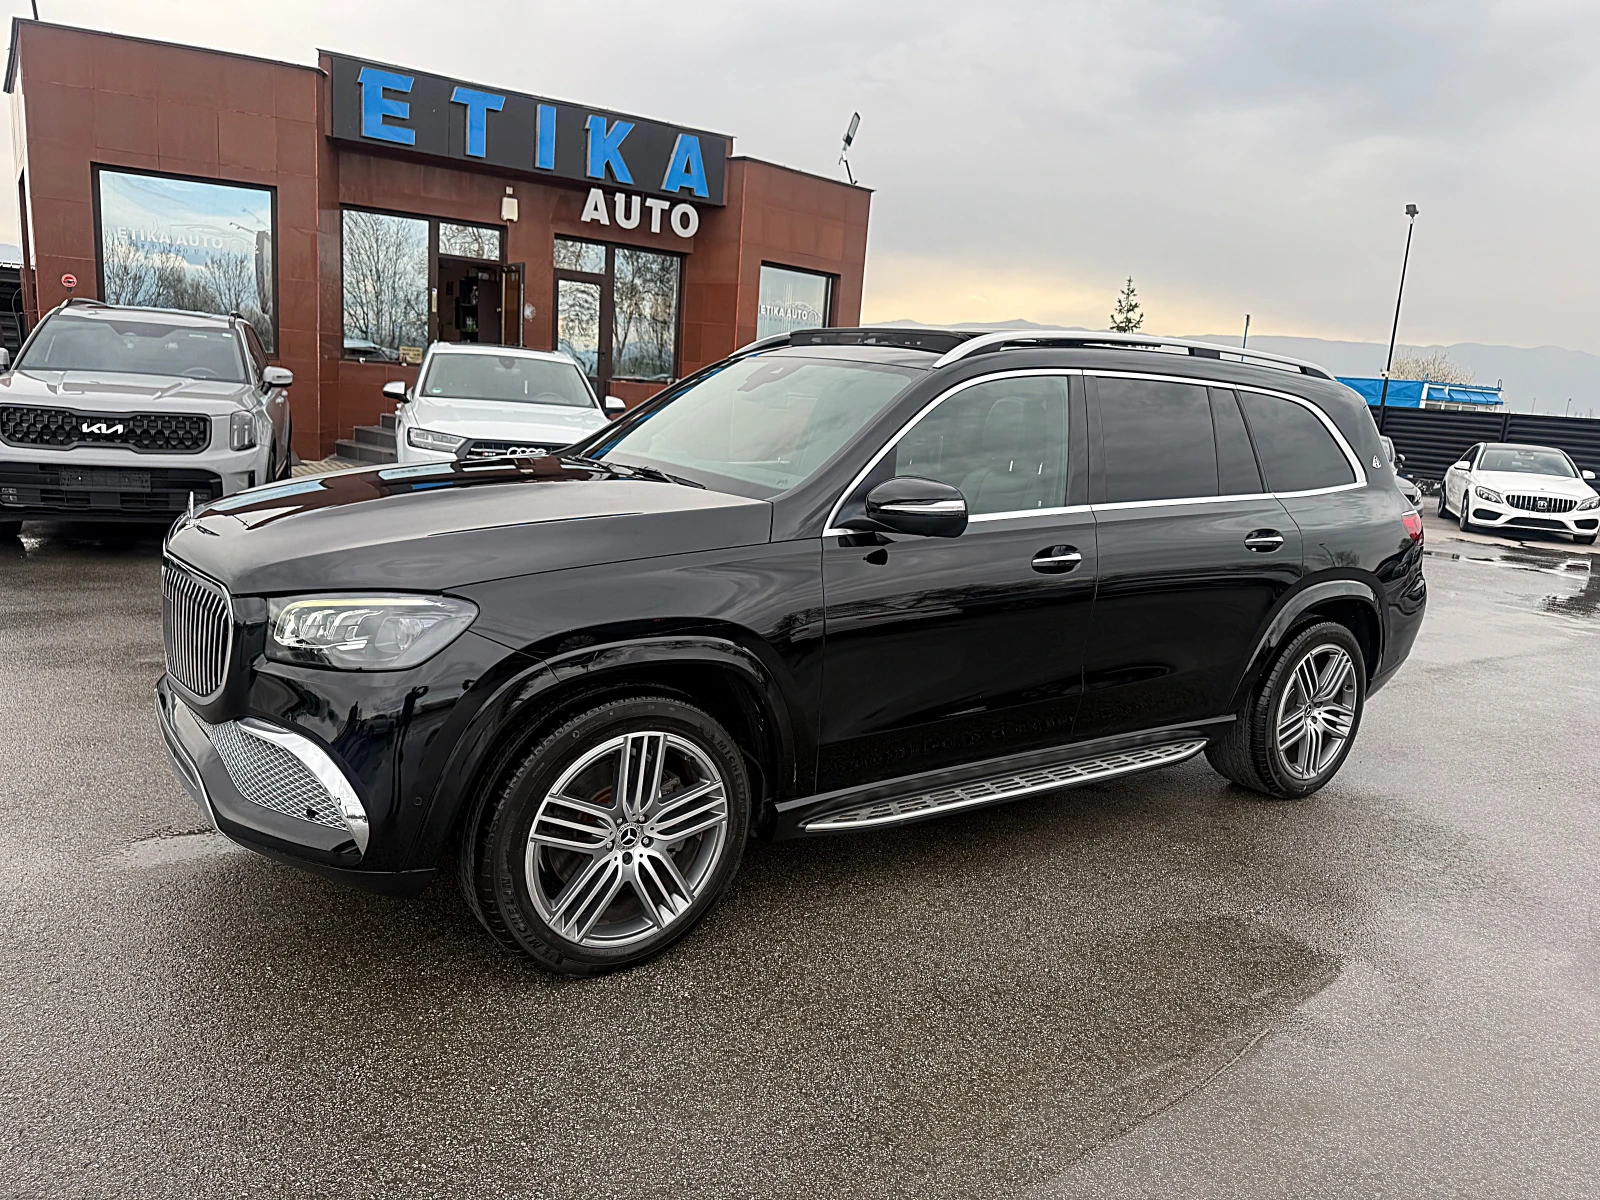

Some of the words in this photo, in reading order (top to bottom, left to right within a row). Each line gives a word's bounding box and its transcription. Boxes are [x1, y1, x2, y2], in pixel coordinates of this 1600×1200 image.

[357, 66, 710, 198] ETIKA
[580, 187, 700, 238] AUTO
[117, 227, 170, 243] ETIKA
[176, 233, 224, 249] AUTO
[760, 305, 784, 317] ETIKA
[787, 308, 807, 320] AUTO
[82, 423, 123, 434] KIA
[500, 876, 544, 949] MICHELIN
